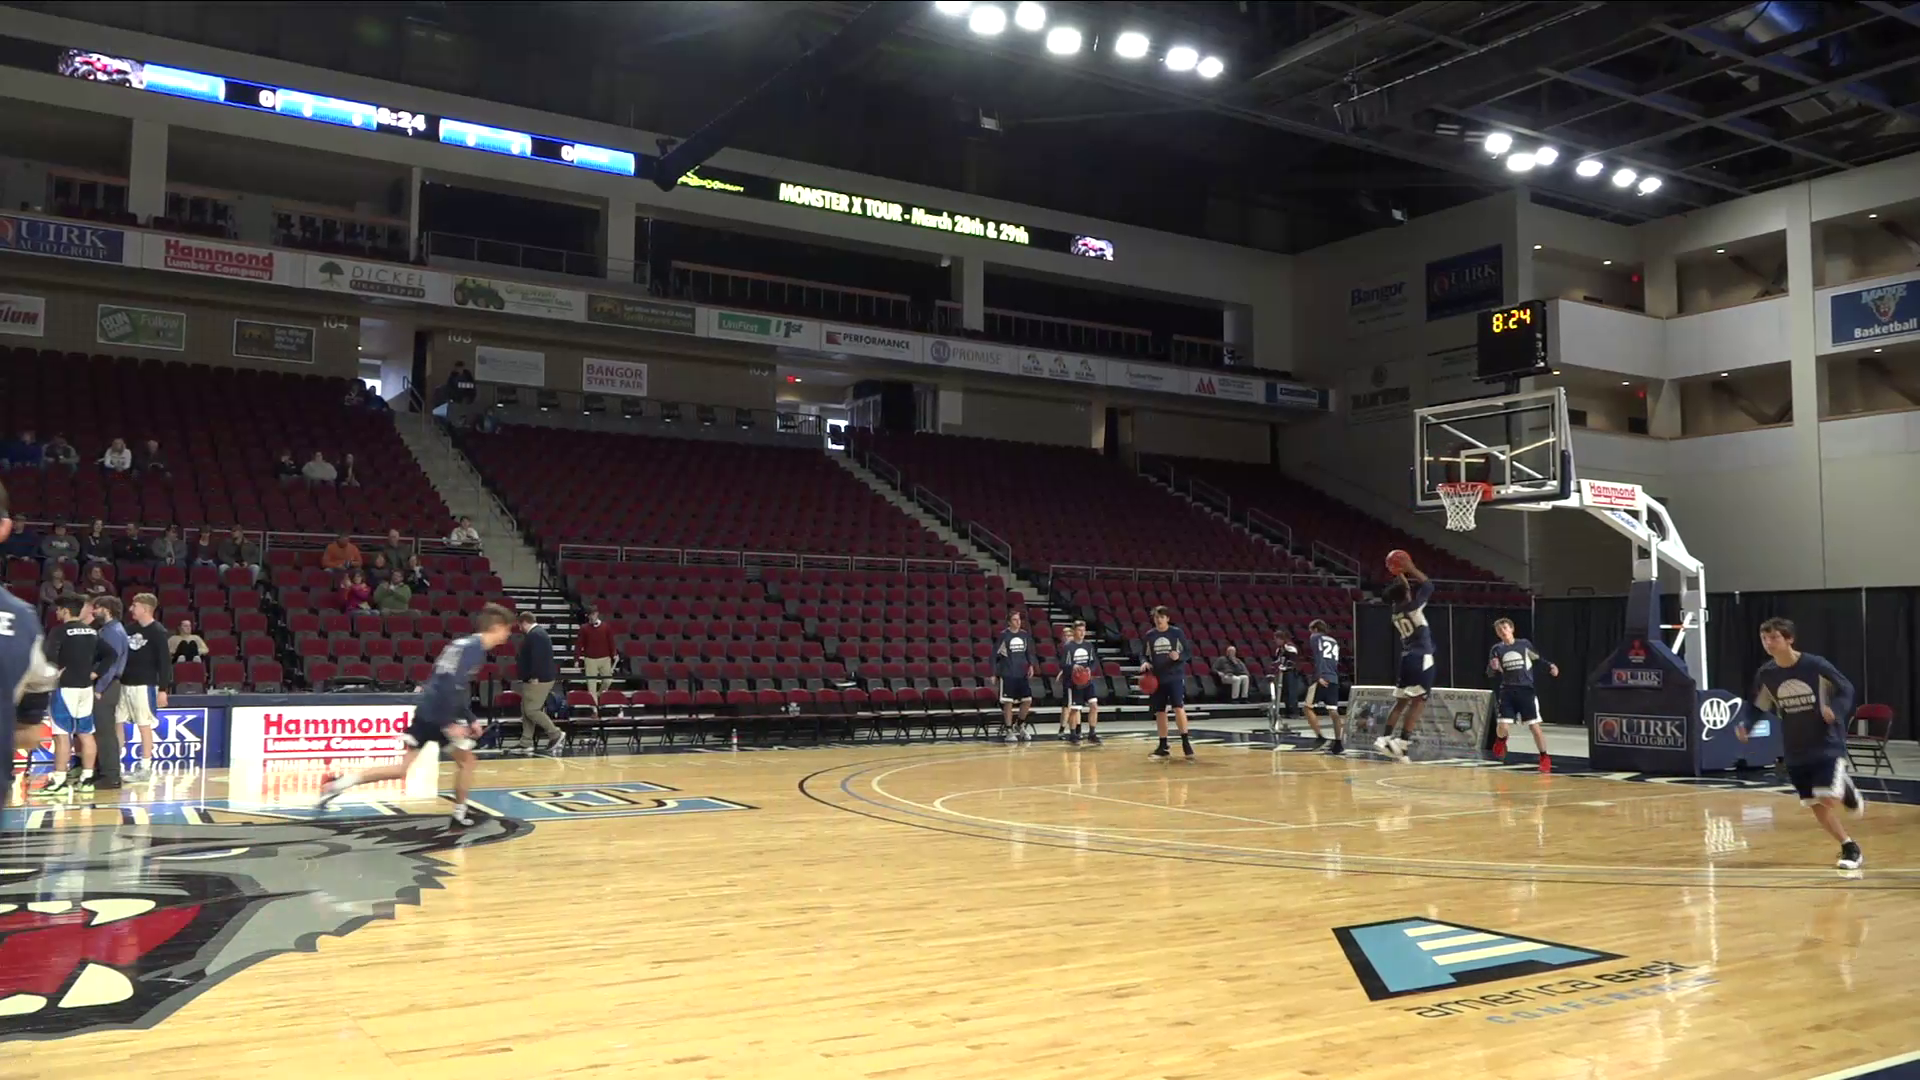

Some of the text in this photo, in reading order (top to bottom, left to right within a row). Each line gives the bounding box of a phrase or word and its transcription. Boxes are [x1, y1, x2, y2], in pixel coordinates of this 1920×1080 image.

[779, 182, 849, 213] MONSTER
[851, 195, 862, 215] X
[864, 198, 903, 222] TOUR
[911, 207, 952, 231] March
[986, 221, 998, 239] &
[999, 223, 1029, 245] 29th
[19, 240, 107, 259] AUTO GROUP
[165, 239, 274, 268] Hammond
[167, 257, 270, 280] Lumber Company
[1350, 281, 1408, 307] Bangor
[1860, 284, 1908, 304] MAINE
[1492, 308, 1530, 333] 8:24
[1853, 318, 1918, 338] Basketball
[843, 333, 910, 350] PERFORMANCE
[952, 347, 1002, 365] PROMISE
[587, 363, 643, 380] BANGOR
[587, 376, 643, 390] STATE FAIR
[1588, 481, 1636, 498] Hammond
[1323, 641, 1340, 661] 24
[1613, 670, 1662, 683] QUIRK
[263, 711, 409, 736] Hammond
[1599, 718, 1683, 742] QUIRK
[266, 737, 405, 751] Lumber Company
[1620, 734, 1685, 748] AUTO GROUP
[1403, 959, 1693, 1018] america east
